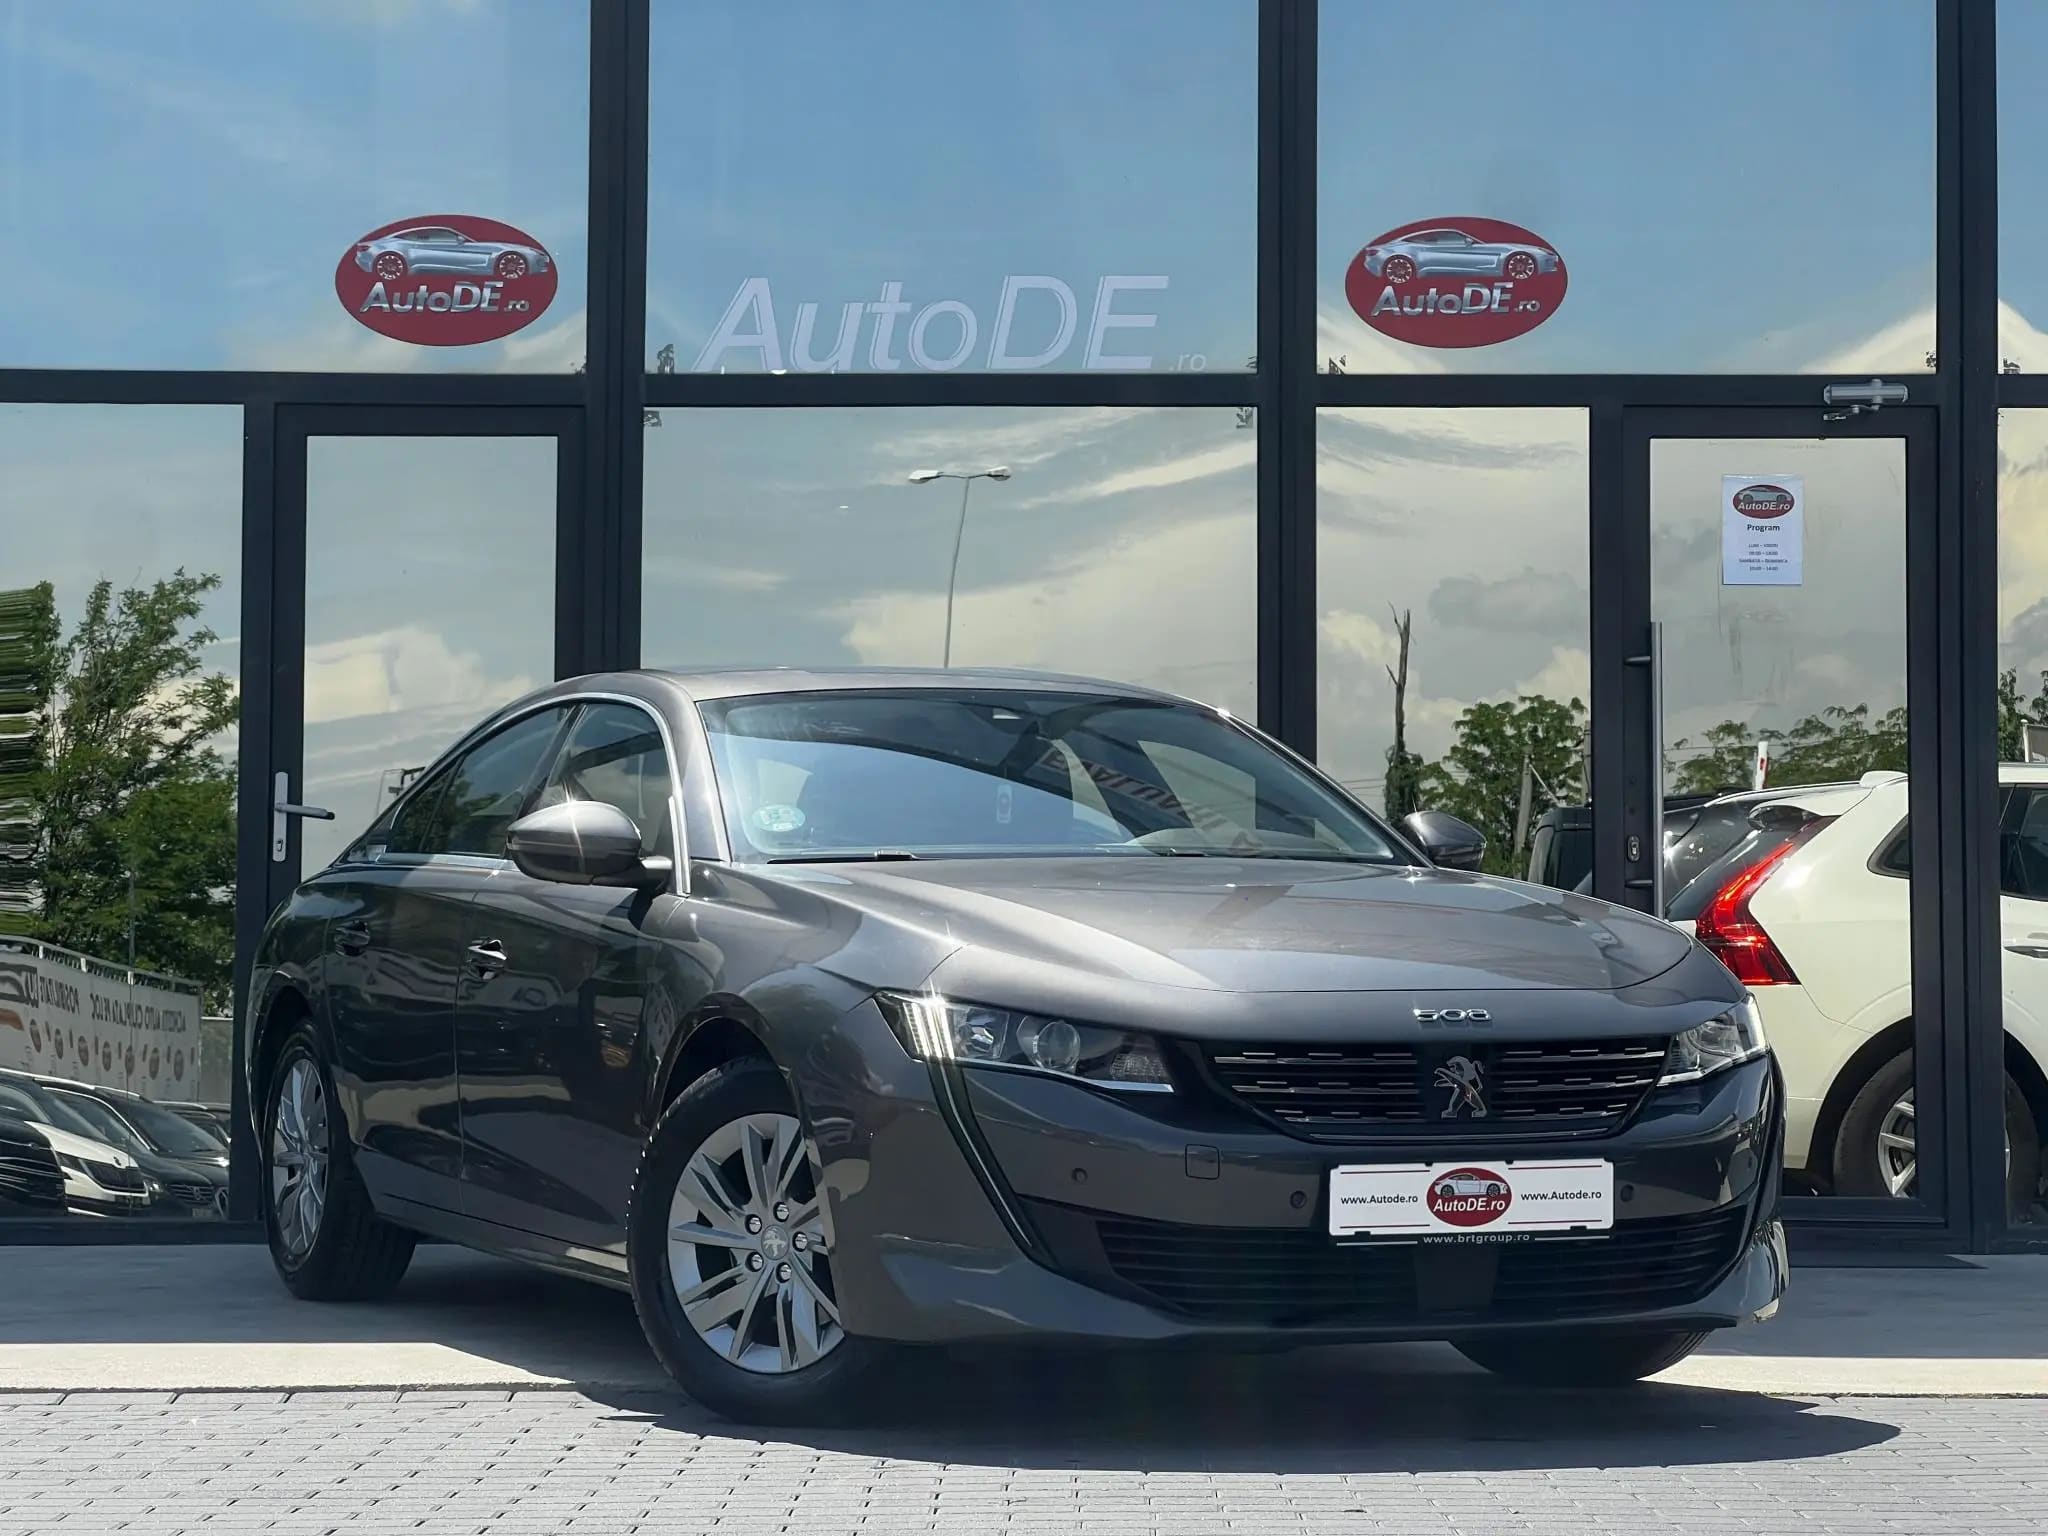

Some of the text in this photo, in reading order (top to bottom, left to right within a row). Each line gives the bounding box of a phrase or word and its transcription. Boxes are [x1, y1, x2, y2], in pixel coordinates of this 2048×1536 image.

[1738, 502, 1790, 511] AutoDE.ro
[1747, 524, 1780, 532] Program
[1413, 1009, 1491, 1021] 508
[1340, 1190, 1602, 1212] www.Autode.ro AutoDE.ro www.Autode.ro
[1423, 1233, 1530, 1245] www.brtgroup.ro
